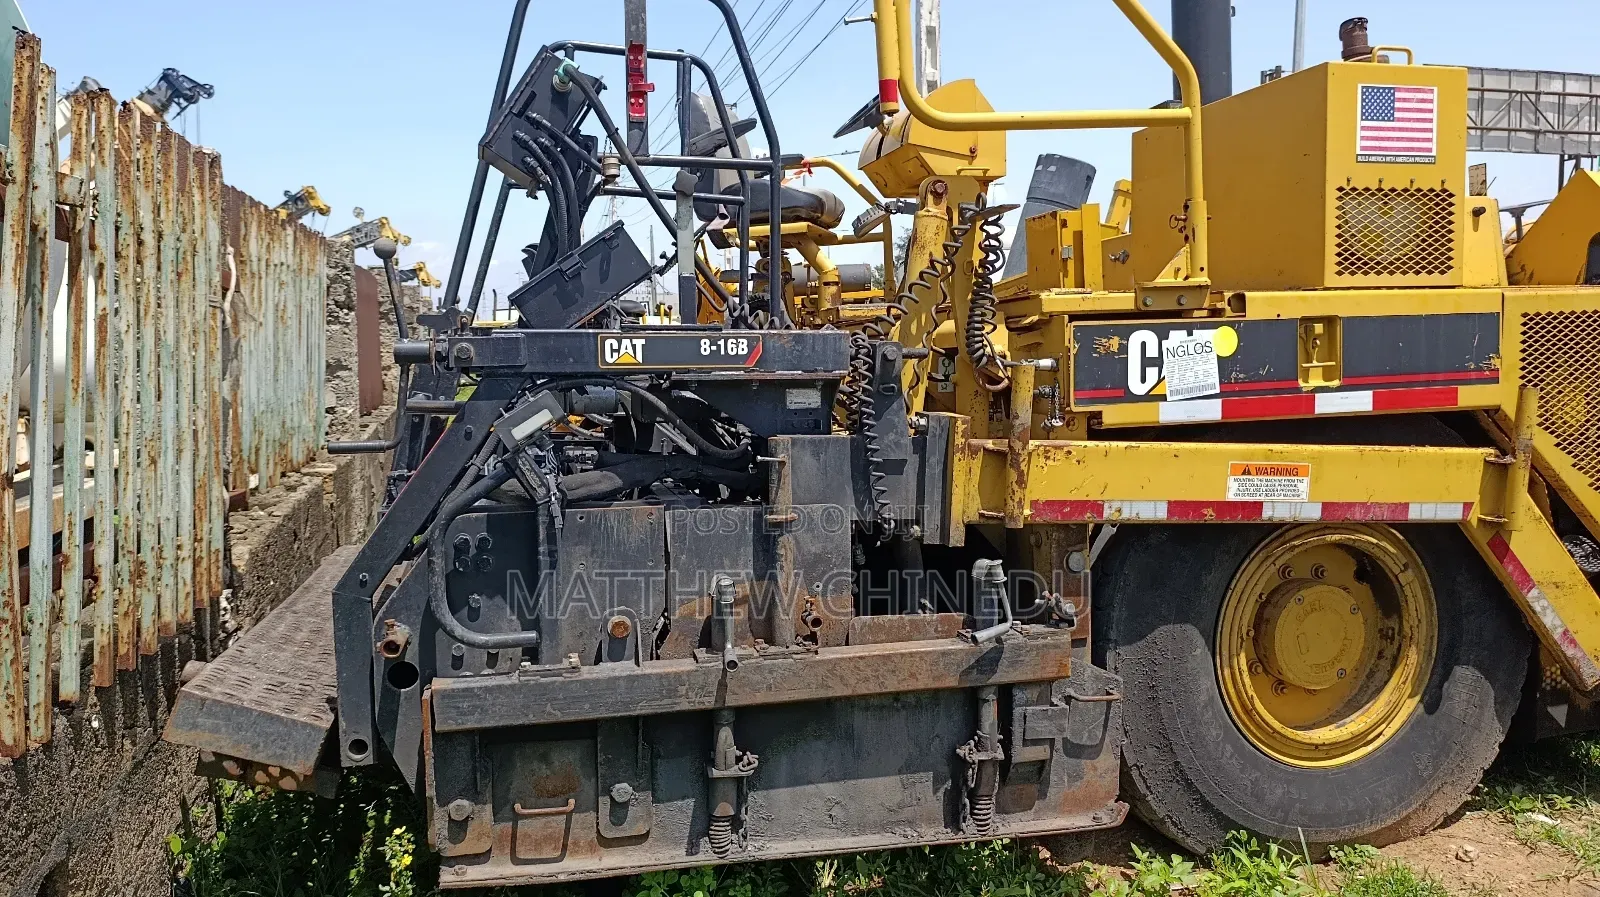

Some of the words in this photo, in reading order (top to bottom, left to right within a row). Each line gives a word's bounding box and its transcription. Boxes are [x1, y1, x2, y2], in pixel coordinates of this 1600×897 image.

[604, 338, 646, 364] CAT
[700, 338, 749, 356] 8-16B
[1166, 340, 1213, 359] NGLOS
[1255, 466, 1298, 476] WARNING
